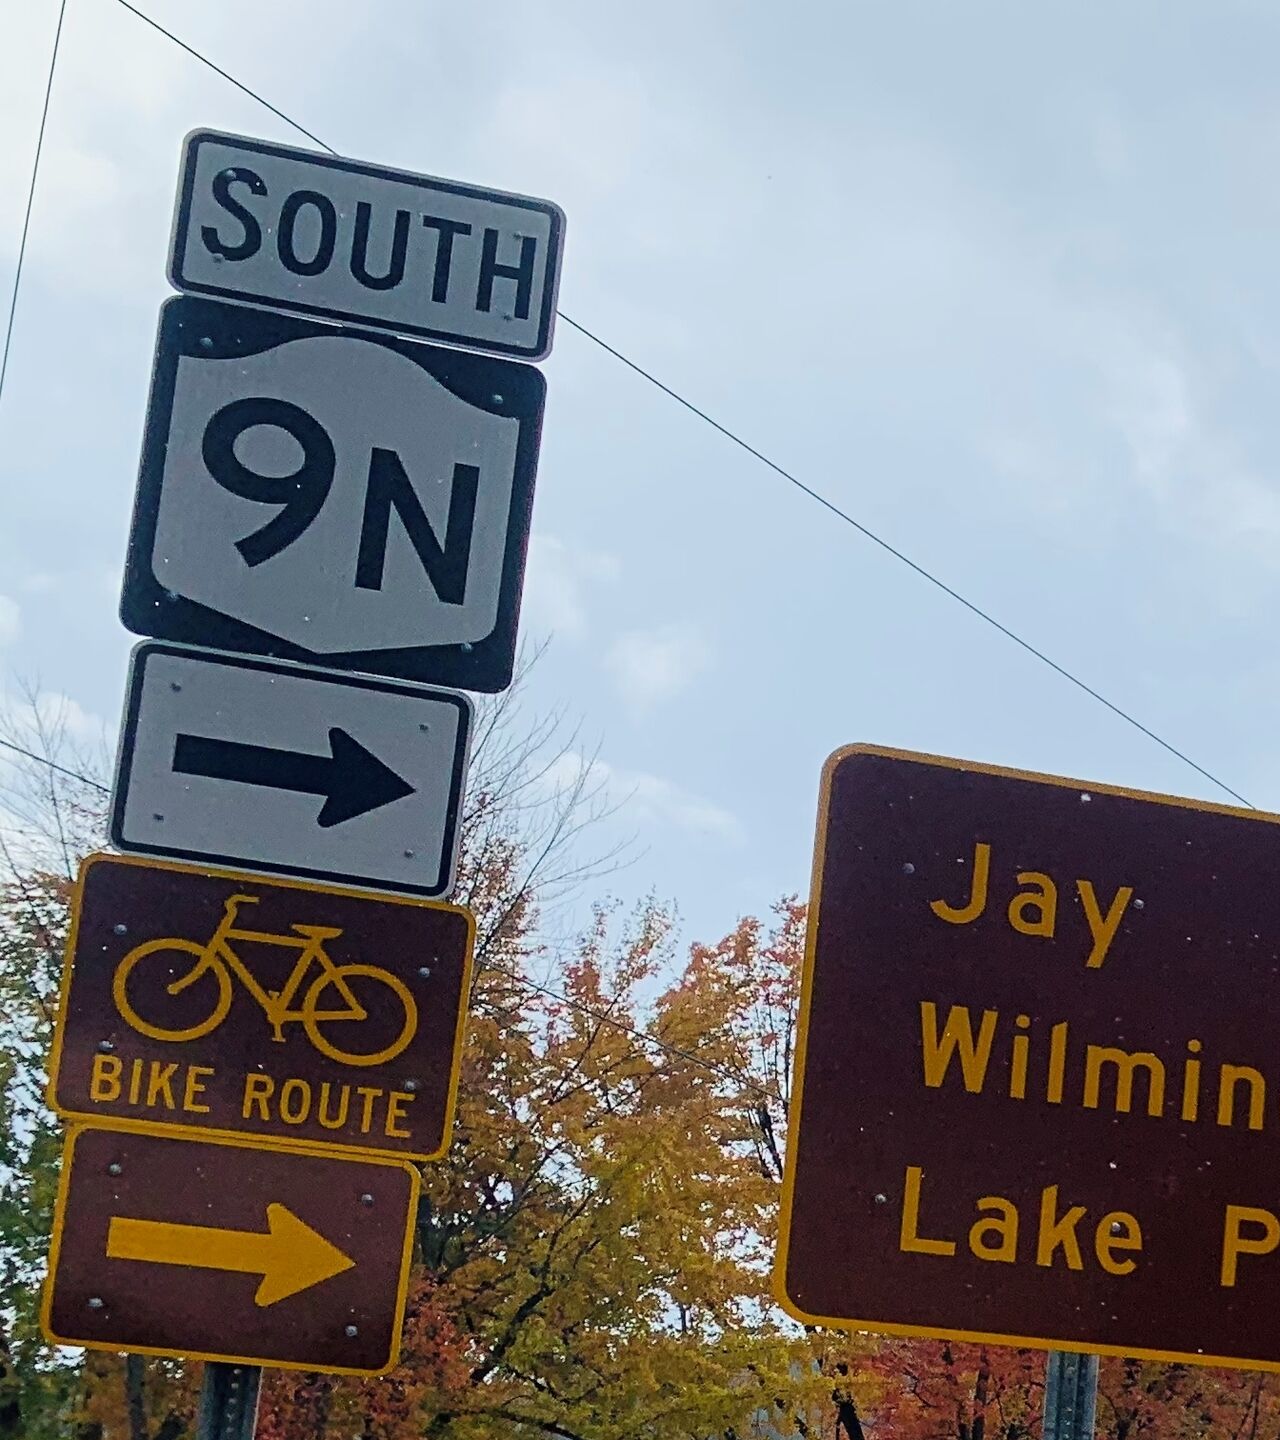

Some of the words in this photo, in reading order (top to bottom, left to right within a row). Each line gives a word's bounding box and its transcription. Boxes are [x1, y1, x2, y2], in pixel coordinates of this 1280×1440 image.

[201, 167, 537, 320] SOUTH
[201, 396, 481, 606] 9N
[929, 842, 1133, 968] Jay
[89, 1054, 215, 1113] BIKE
[242, 1073, 416, 1138] ROUTE
[900, 1166, 1144, 1275] Lake
